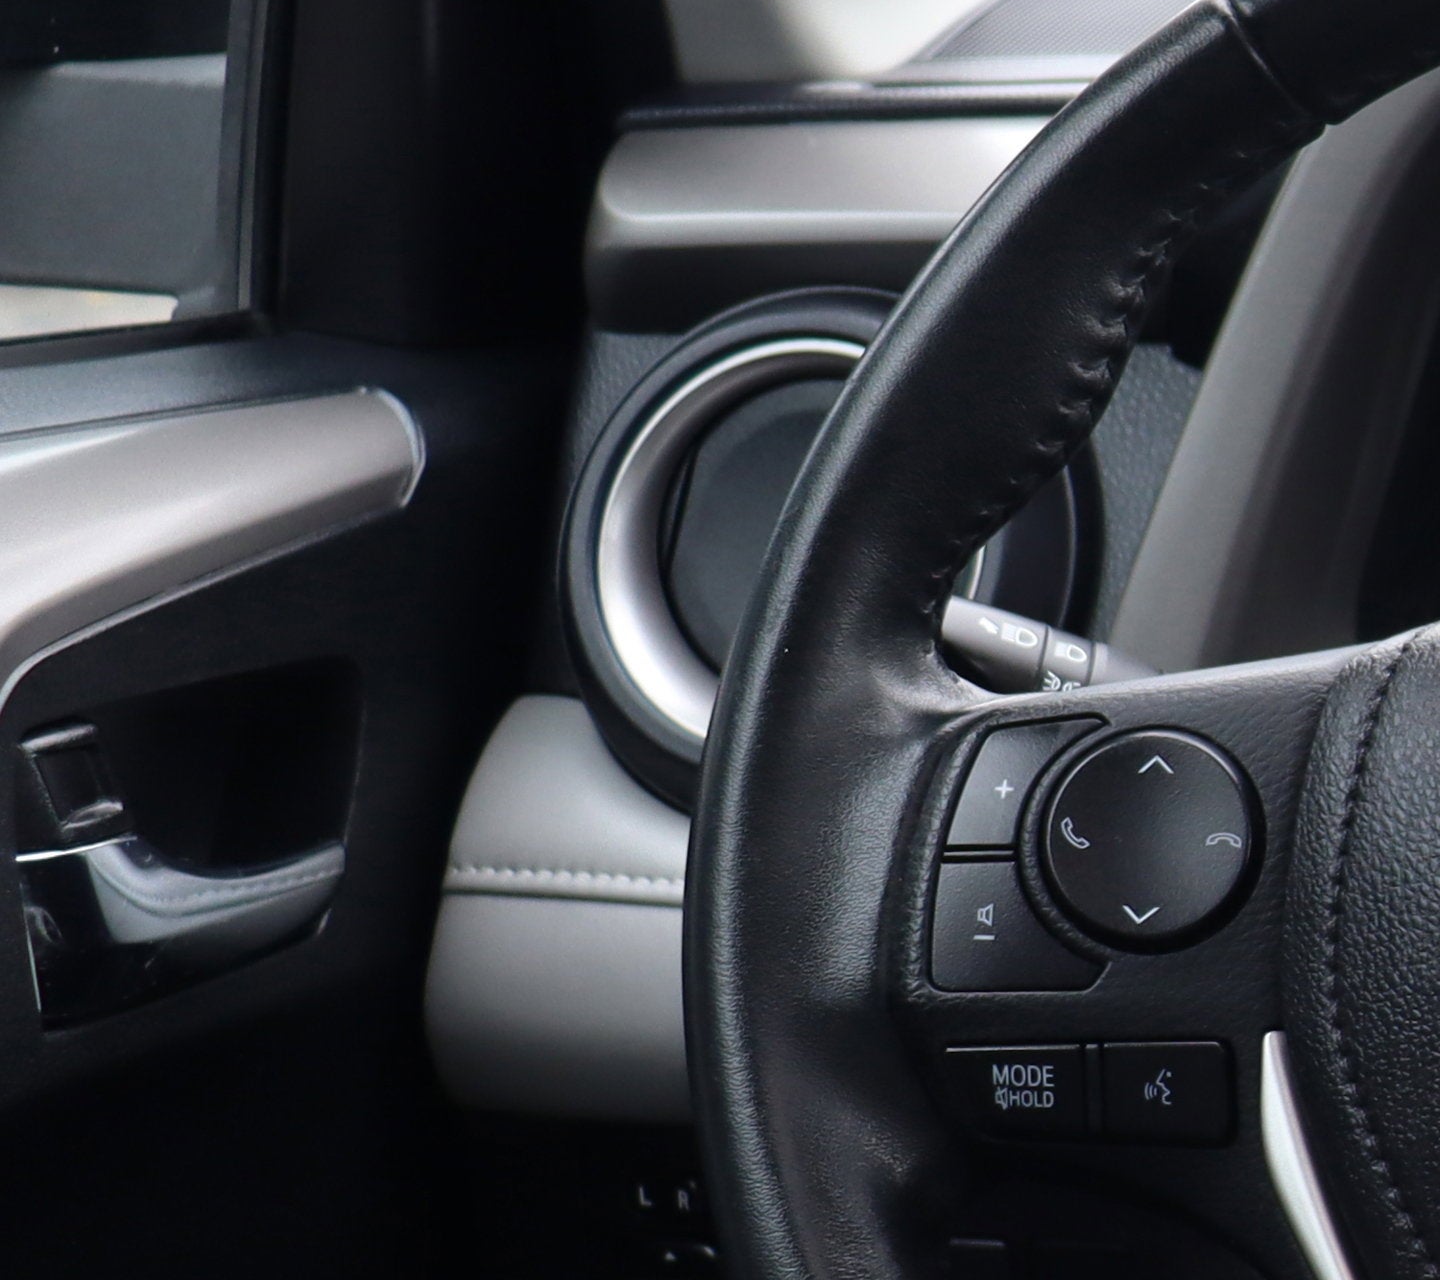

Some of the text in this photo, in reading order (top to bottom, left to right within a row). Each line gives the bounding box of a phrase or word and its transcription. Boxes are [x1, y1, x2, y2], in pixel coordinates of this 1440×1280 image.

[991, 1063, 1056, 1087] MODE
[1008, 1089, 1055, 1109] HOLD
[637, 1184, 690, 1212] L R
